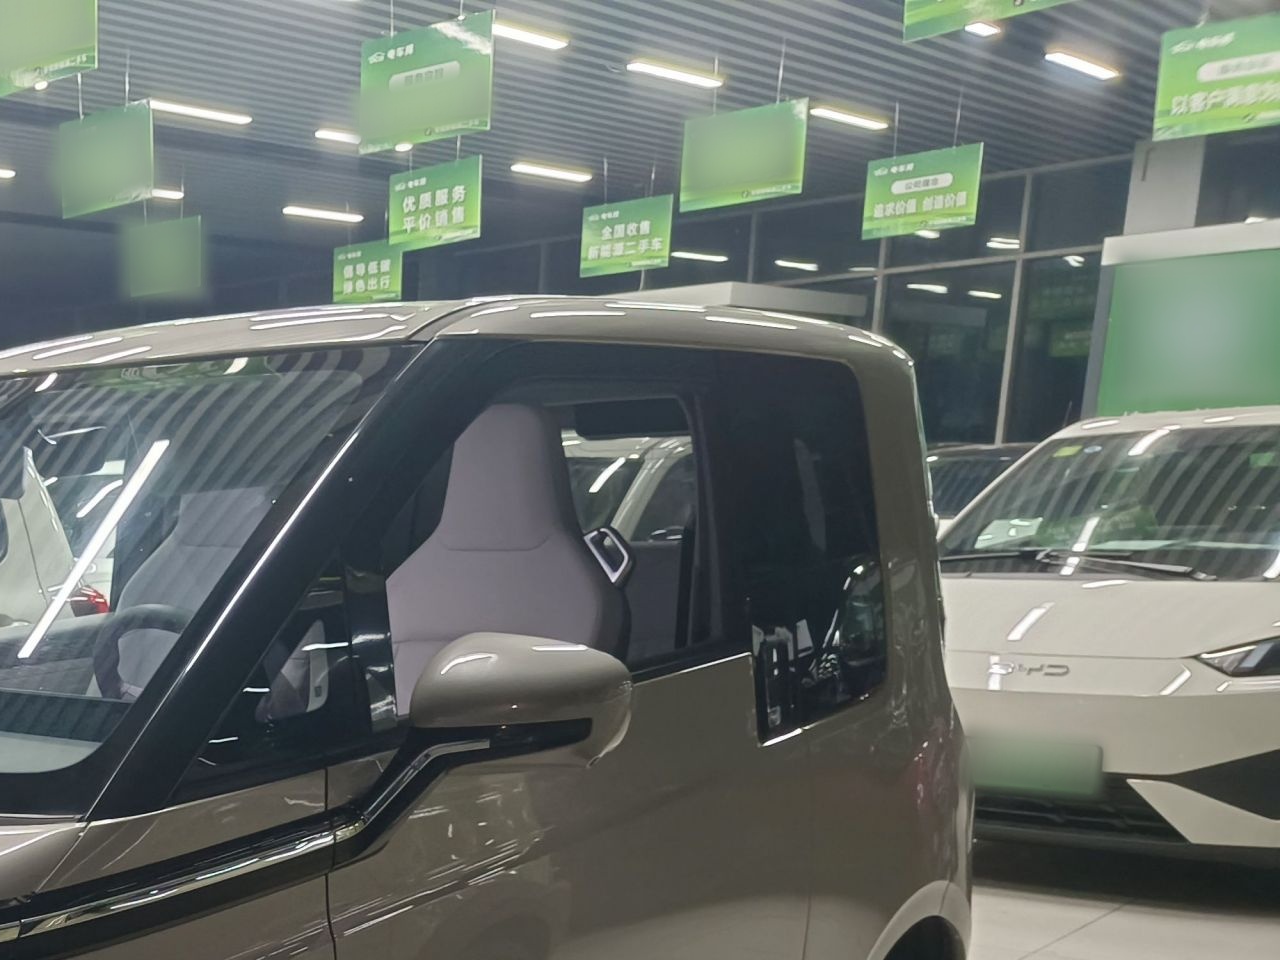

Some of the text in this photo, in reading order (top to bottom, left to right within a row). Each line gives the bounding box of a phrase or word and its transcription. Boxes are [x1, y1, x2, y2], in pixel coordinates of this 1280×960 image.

[402, 185, 466, 214] 优质服务
[873, 191, 968, 218] 追求价值 创造价值
[402, 206, 465, 234] 平价销售
[601, 220, 651, 240] 全国收售
[588, 237, 663, 260] 新能源二手车
[343, 259, 391, 280] 倡导低碳
[342, 275, 391, 295] 绿色出行
